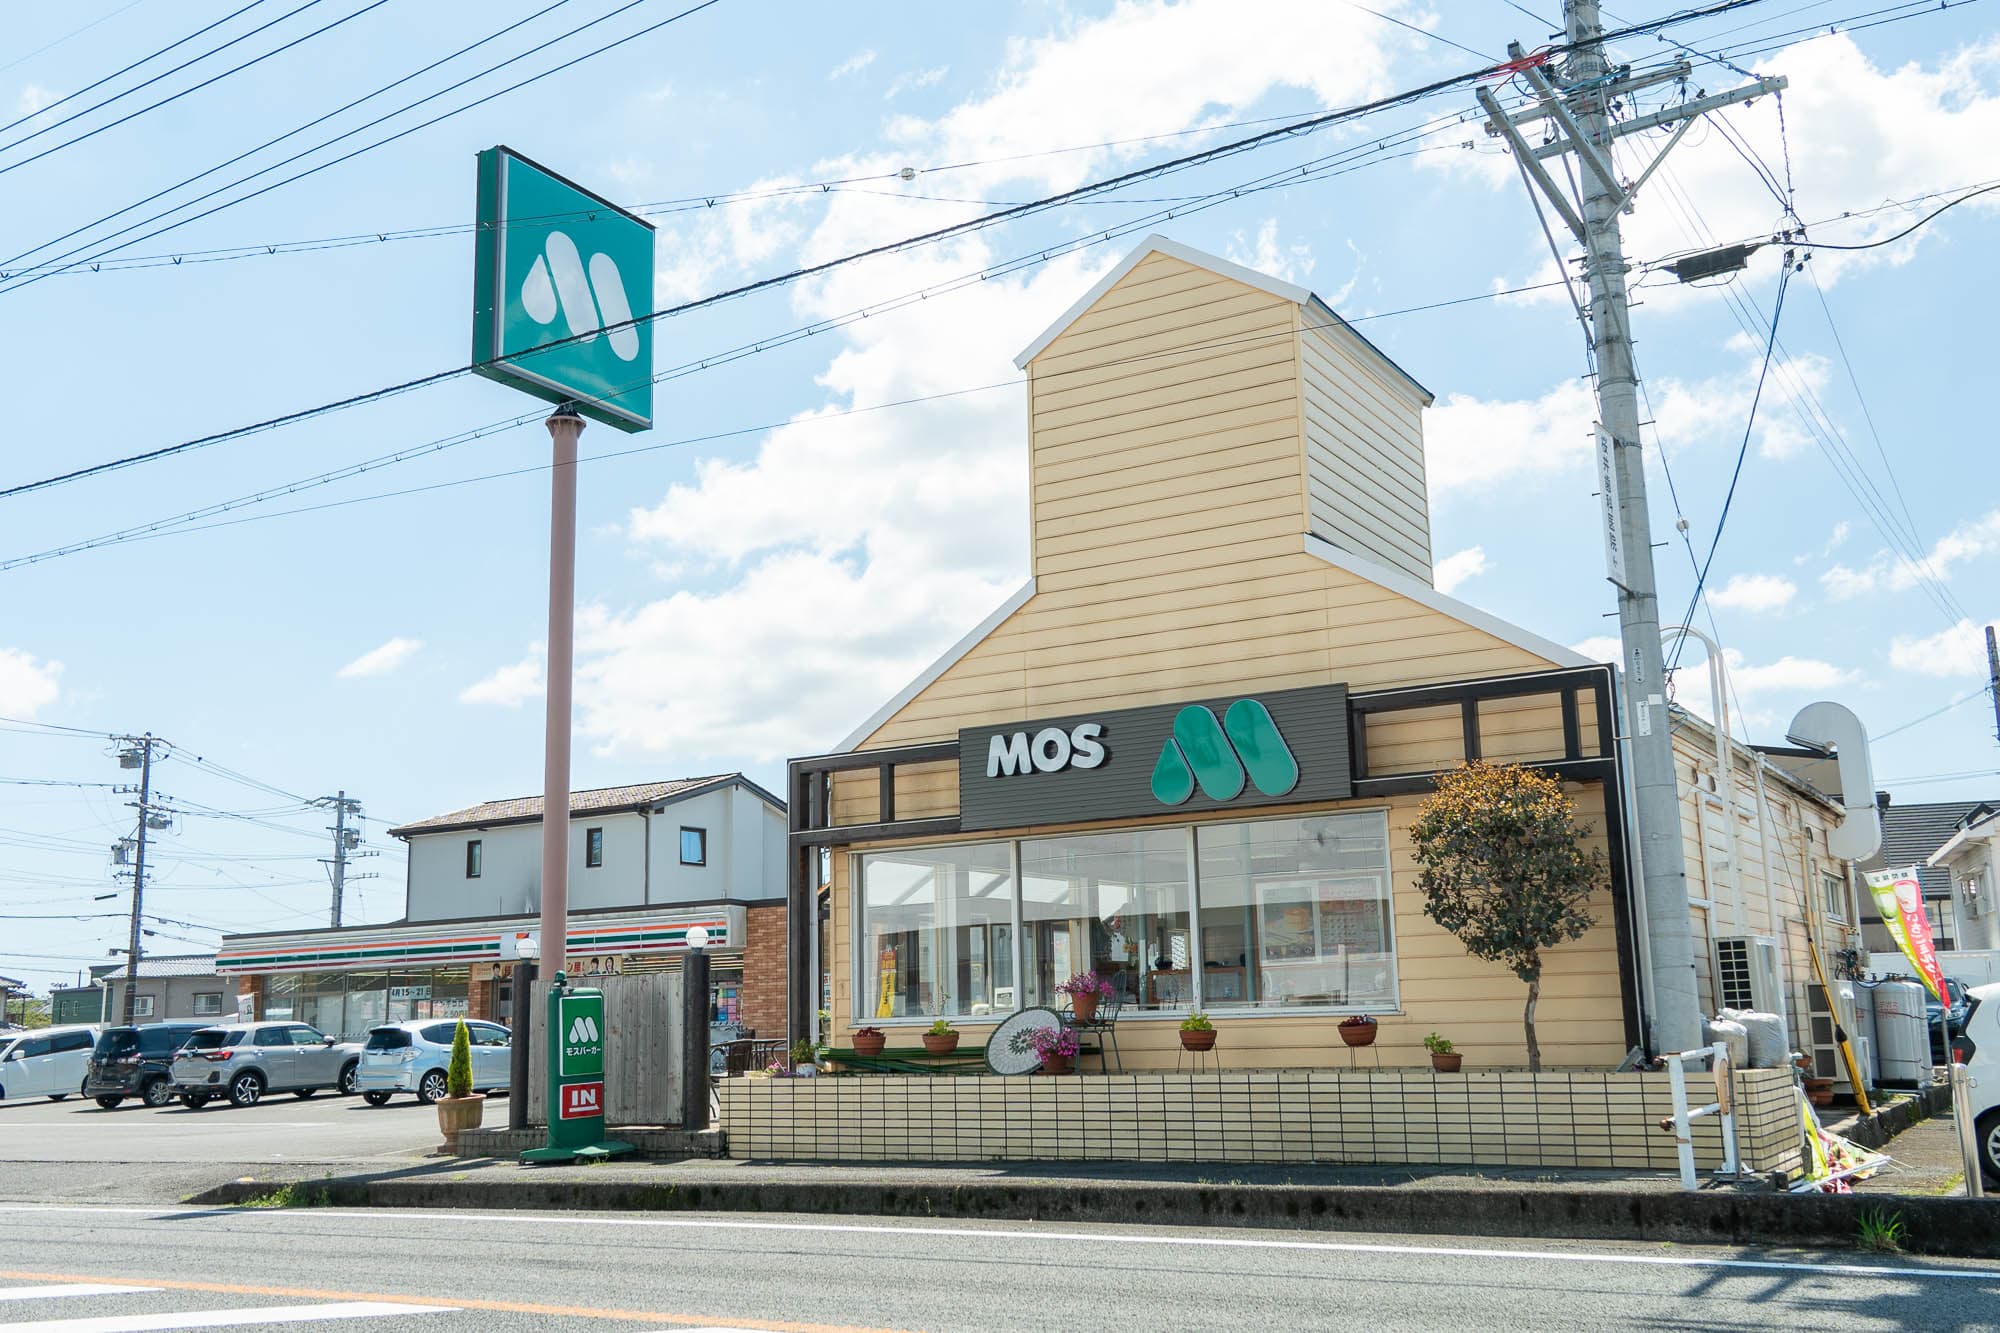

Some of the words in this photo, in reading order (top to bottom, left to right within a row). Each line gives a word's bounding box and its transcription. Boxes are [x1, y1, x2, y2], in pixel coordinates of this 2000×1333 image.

[986, 723, 1106, 778] MOS
[566, 1046, 601, 1056] モスバーガー
[571, 1088, 596, 1106] IN
